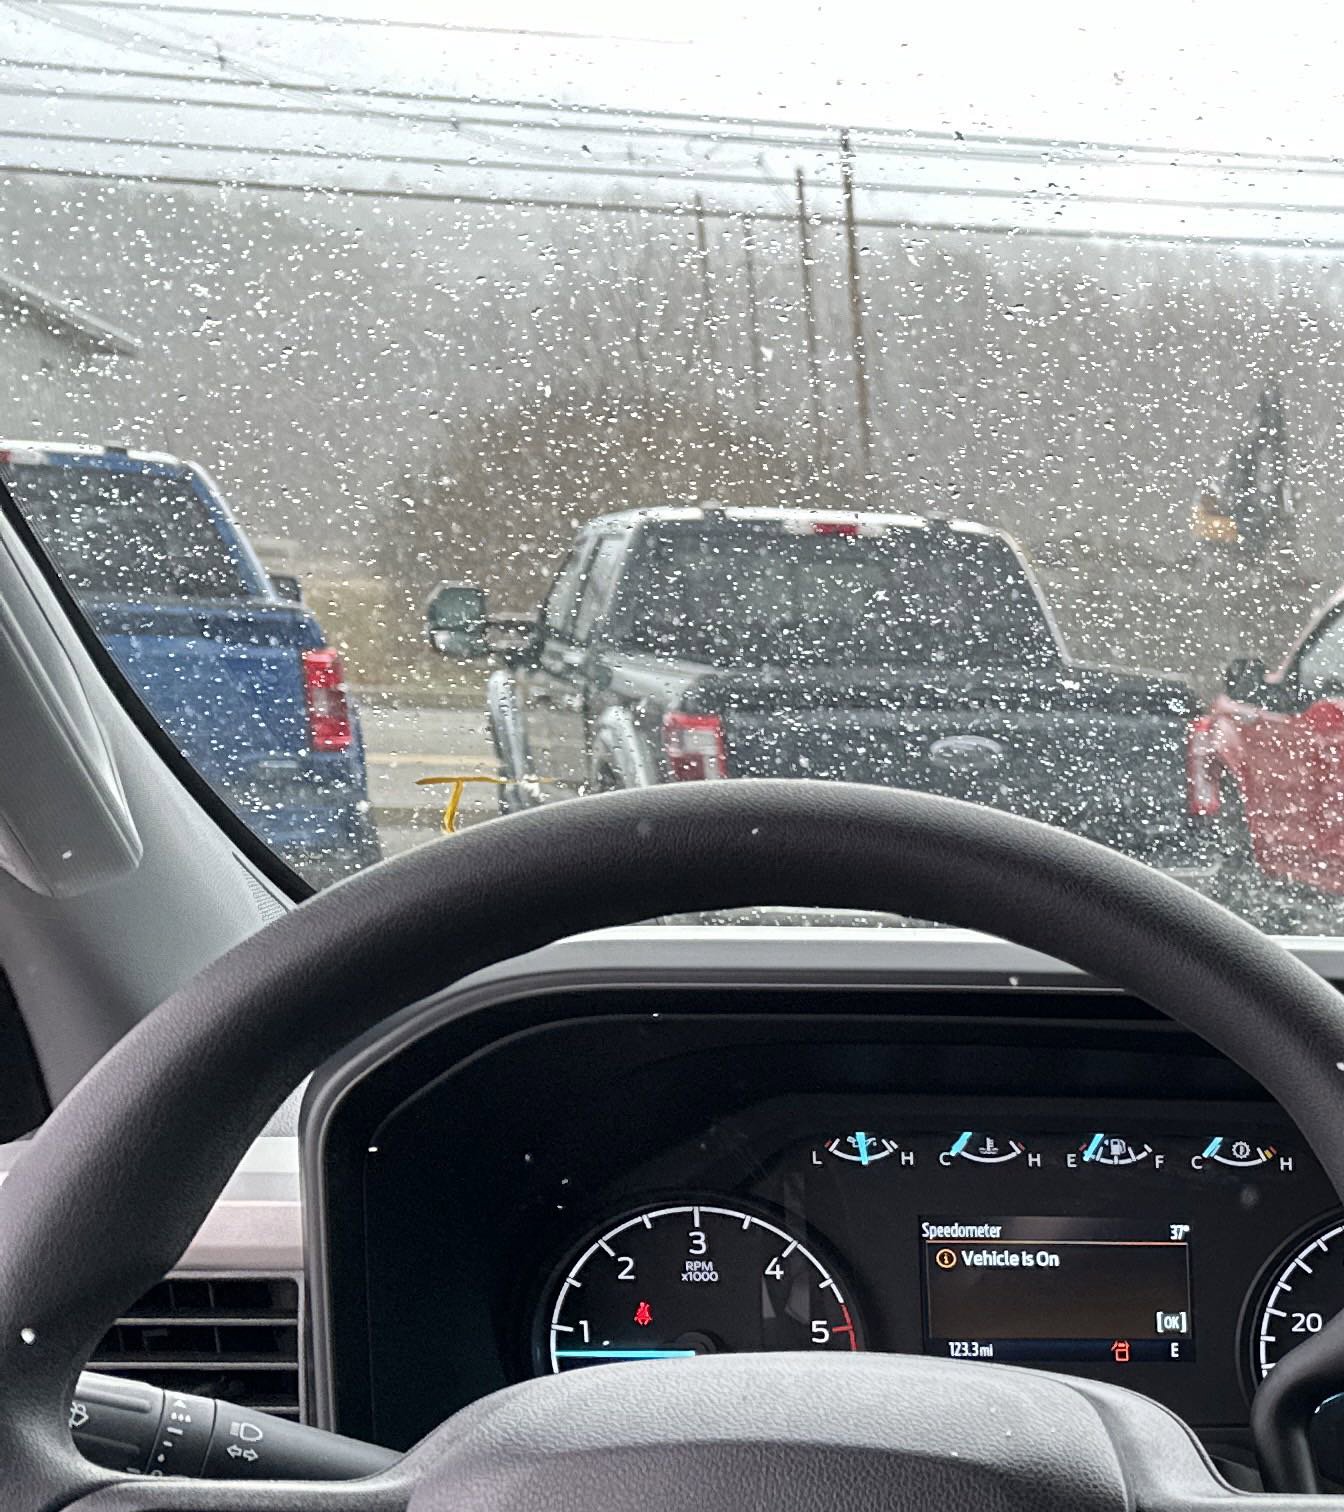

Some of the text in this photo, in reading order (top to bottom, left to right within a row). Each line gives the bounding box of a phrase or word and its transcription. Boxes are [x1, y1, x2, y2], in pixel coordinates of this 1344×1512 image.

[812, 1152, 822, 1165] L
[901, 1152, 914, 1165] H
[939, 1152, 951, 1165] C
[1028, 1154, 1041, 1167] H
[1067, 1154, 1077, 1167] E
[1155, 1155, 1165, 1169] F
[1191, 1156, 1203, 1170] C
[1280, 1157, 1293, 1171] H
[921, 1222, 1002, 1240] Speedometer
[688, 1231, 708, 1255] 3
[961, 1250, 1020, 1266] Vehicle
[1036, 1250, 1060, 1267] On
[617, 1256, 635, 1280] 2
[685, 1260, 714, 1272] RPM
[764, 1257, 784, 1280] 4
[681, 1271, 719, 1283] x1000
[1291, 1313, 1323, 1332] 20
[579, 1320, 590, 1343] 1
[811, 1320, 830, 1343] 5
[1170, 1342, 1179, 1358] E
